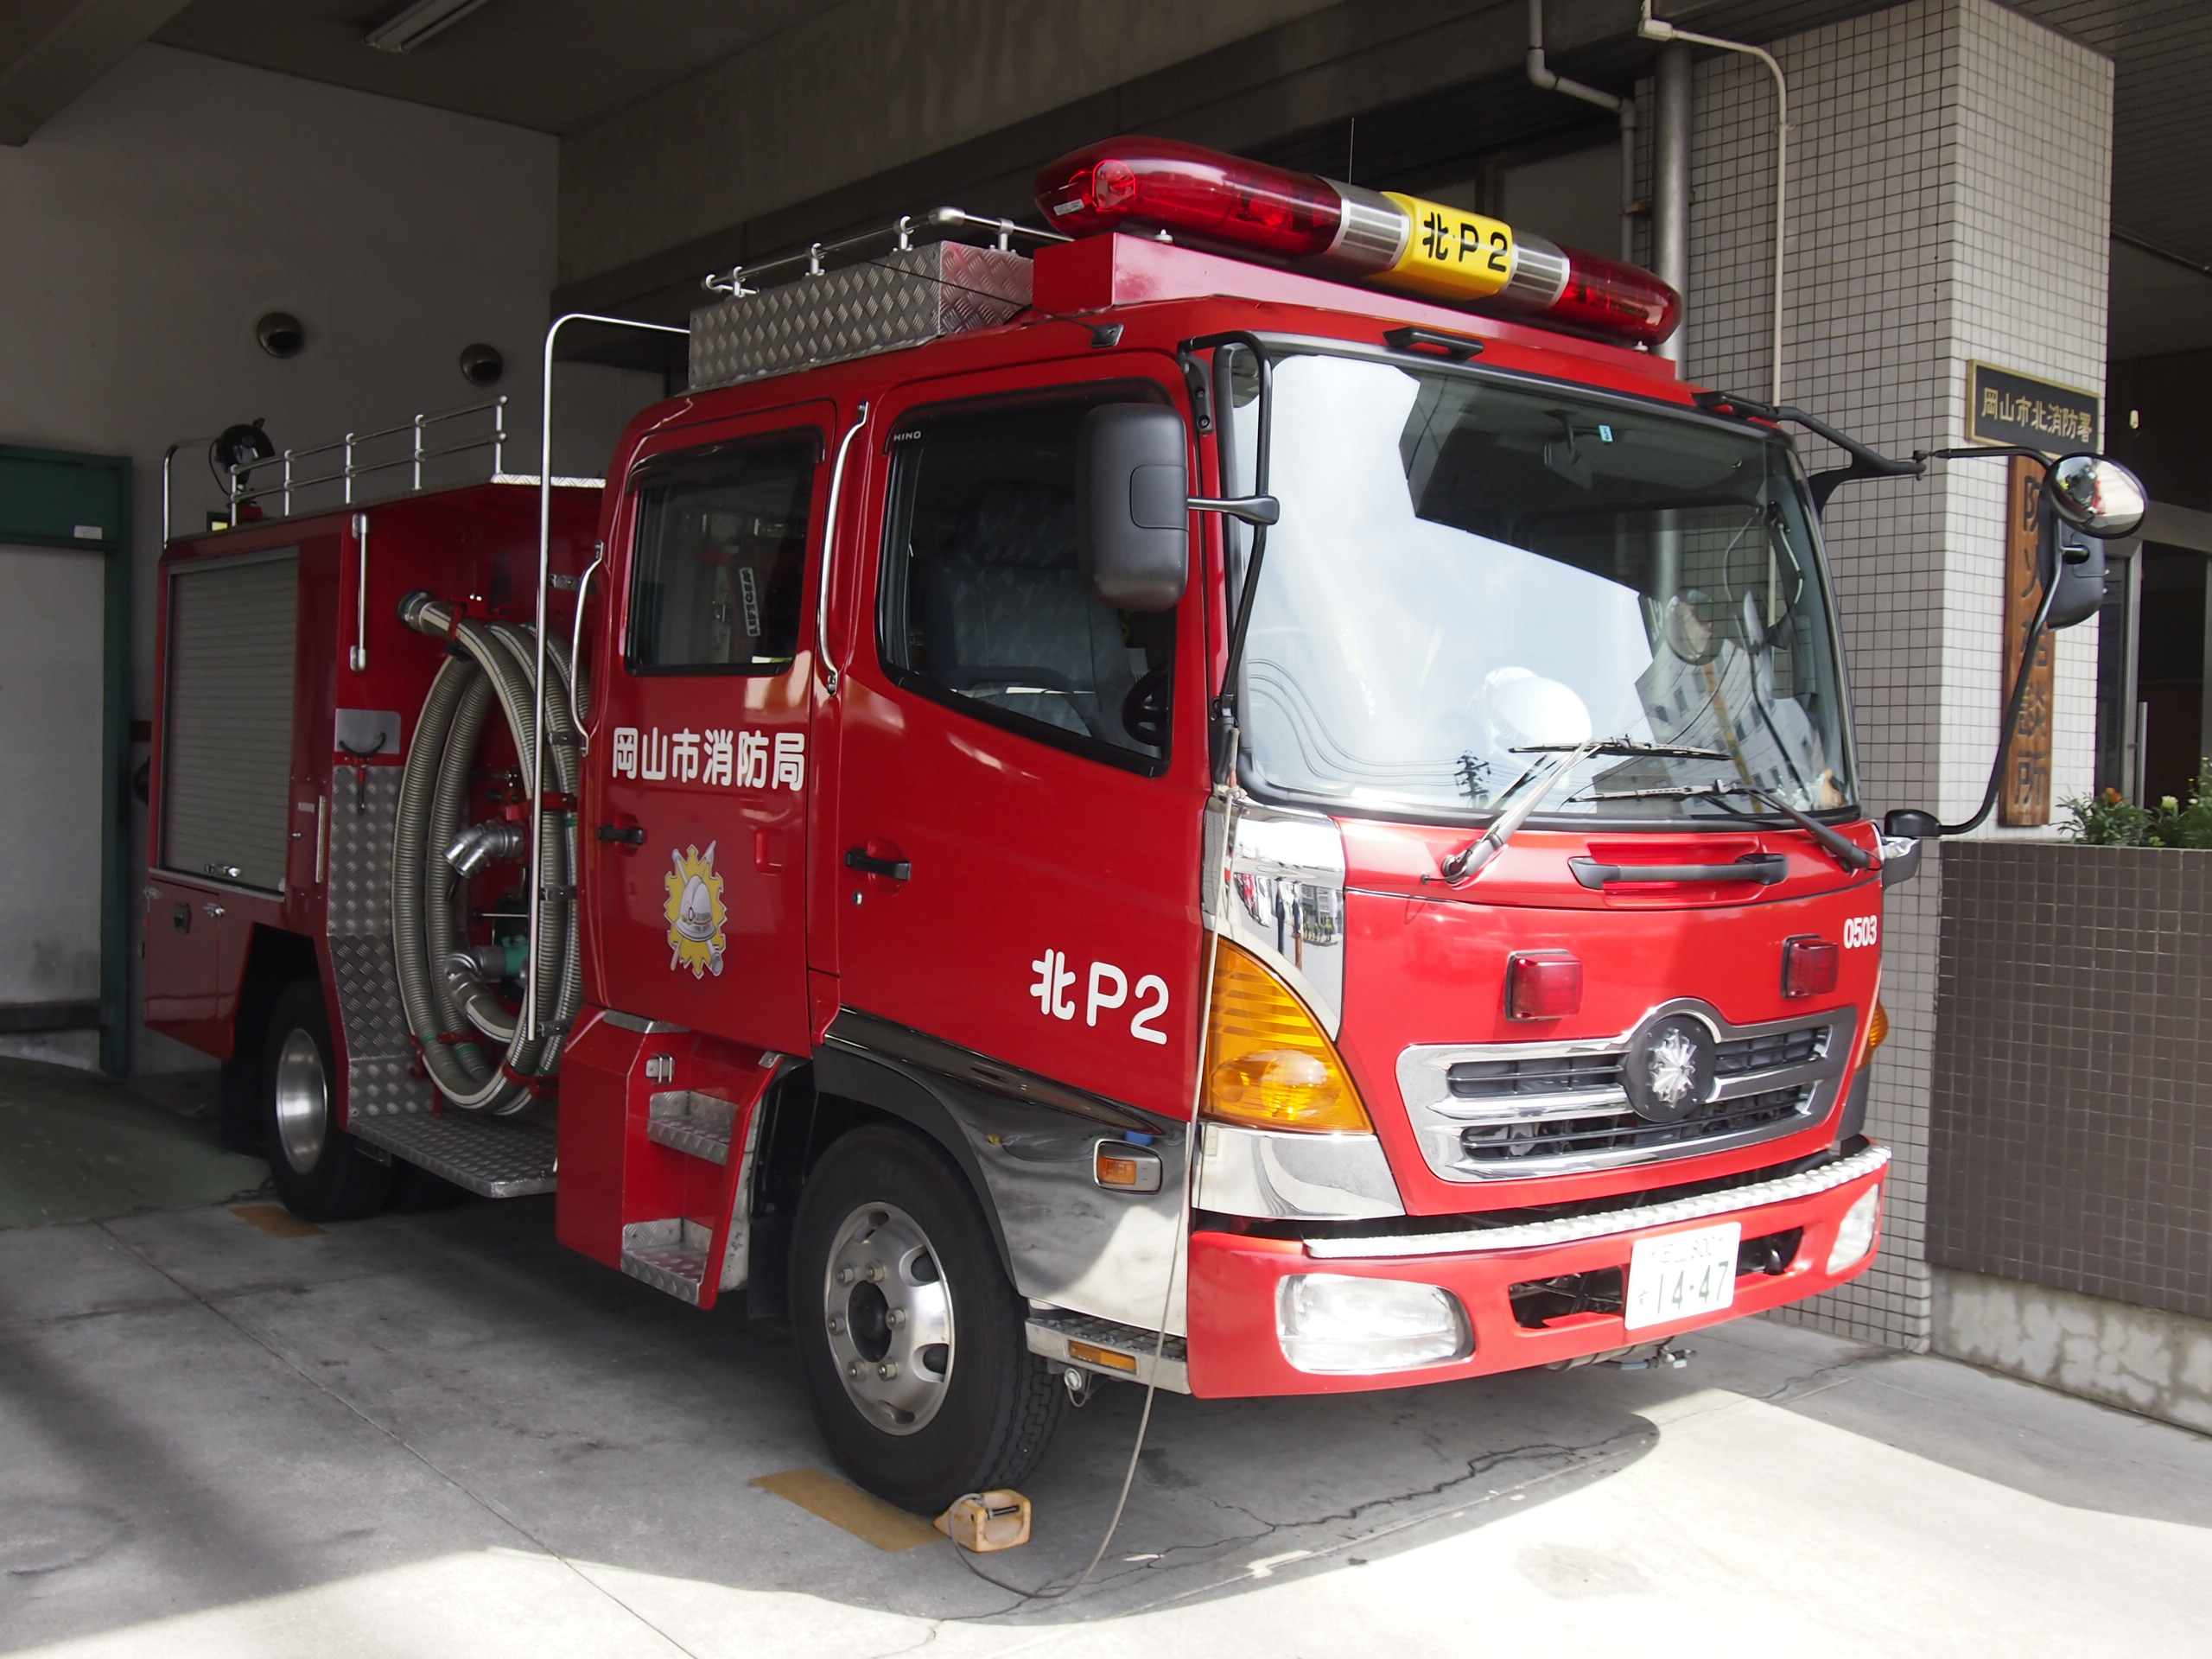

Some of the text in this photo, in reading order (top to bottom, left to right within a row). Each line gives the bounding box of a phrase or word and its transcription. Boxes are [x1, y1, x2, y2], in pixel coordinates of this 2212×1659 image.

[893, 430, 922, 442] HINO
[1981, 387, 2093, 443] 岡山市北消防署
[612, 727, 805, 791] 岡山市消防局
[1843, 914, 1878, 950] 0503
[1030, 948, 1169, 1046] 北P2
